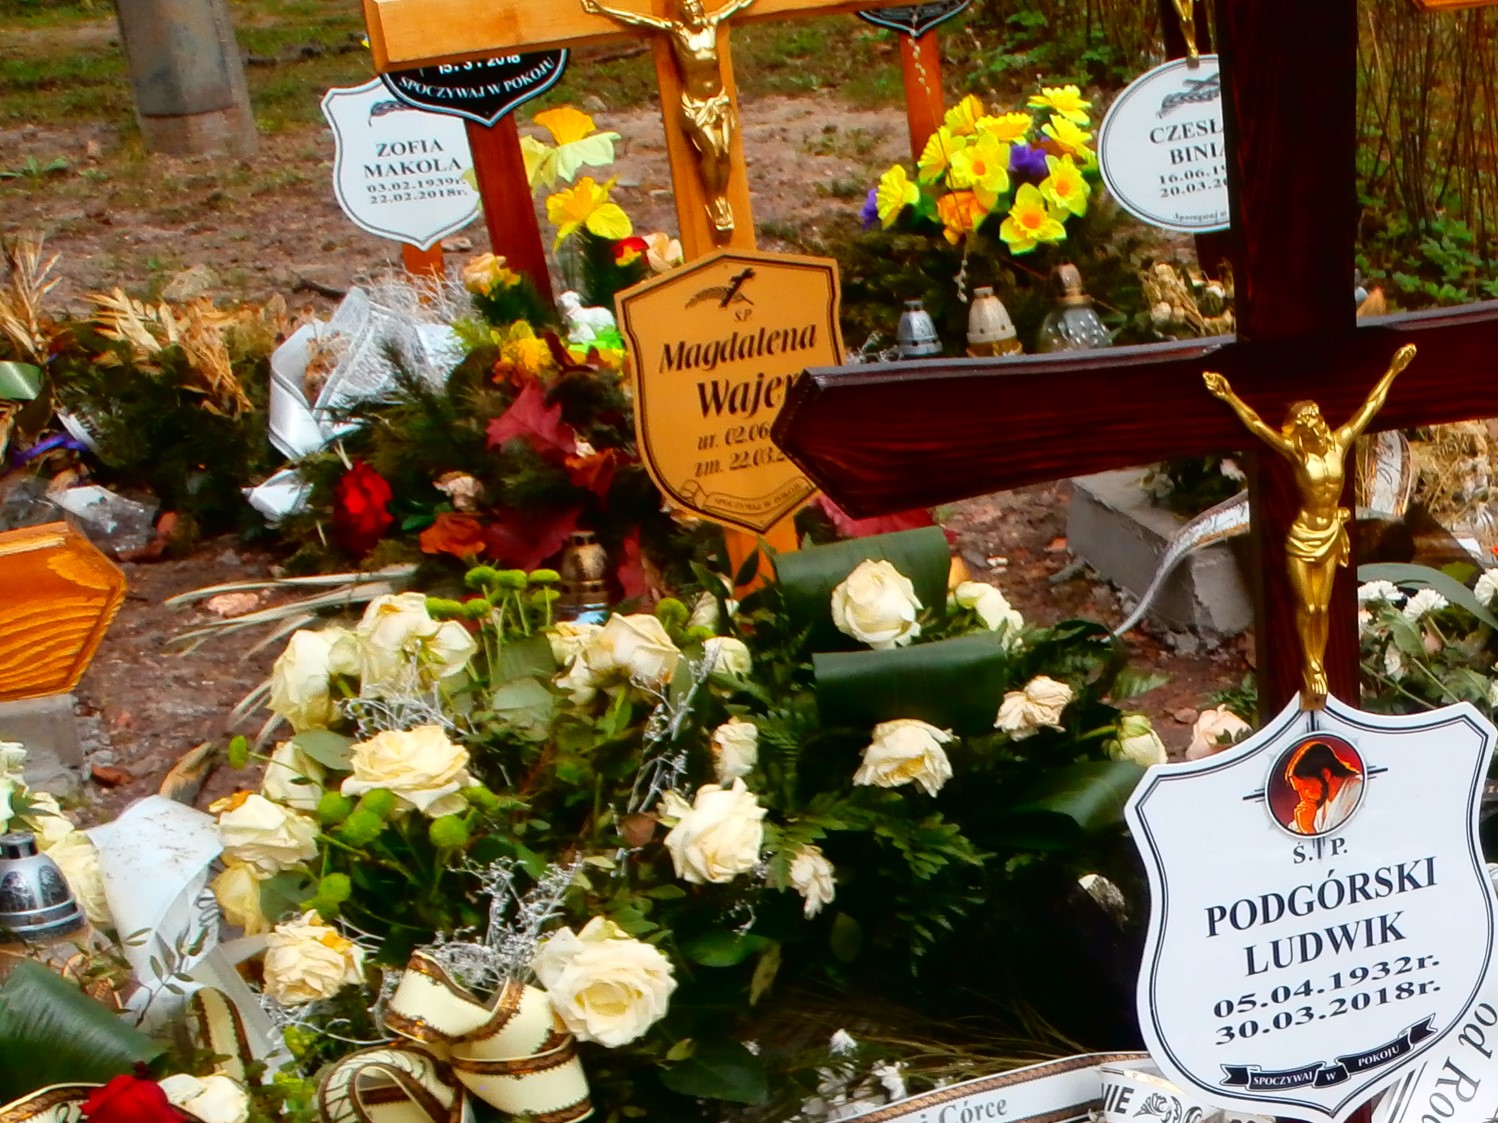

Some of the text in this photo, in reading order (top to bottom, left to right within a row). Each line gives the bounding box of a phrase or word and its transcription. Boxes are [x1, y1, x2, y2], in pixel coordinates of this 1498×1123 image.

[399, 56, 555, 99] SPOCZYWAJ W POKOJU
[375, 139, 444, 157] ZOFIA
[659, 324, 817, 374] Magdalena
[1204, 855, 1438, 938] PODGÓRSKI
[1243, 910, 1407, 977] LUDWIK
[1213, 954, 1440, 1018] 05.04.1932r.
[1214, 979, 1441, 1046] 30.03.2018r.
[1458, 1002, 1498, 1059] od
[1253, 1045, 1400, 1086] SPOCZYWAJ W POKOJU
